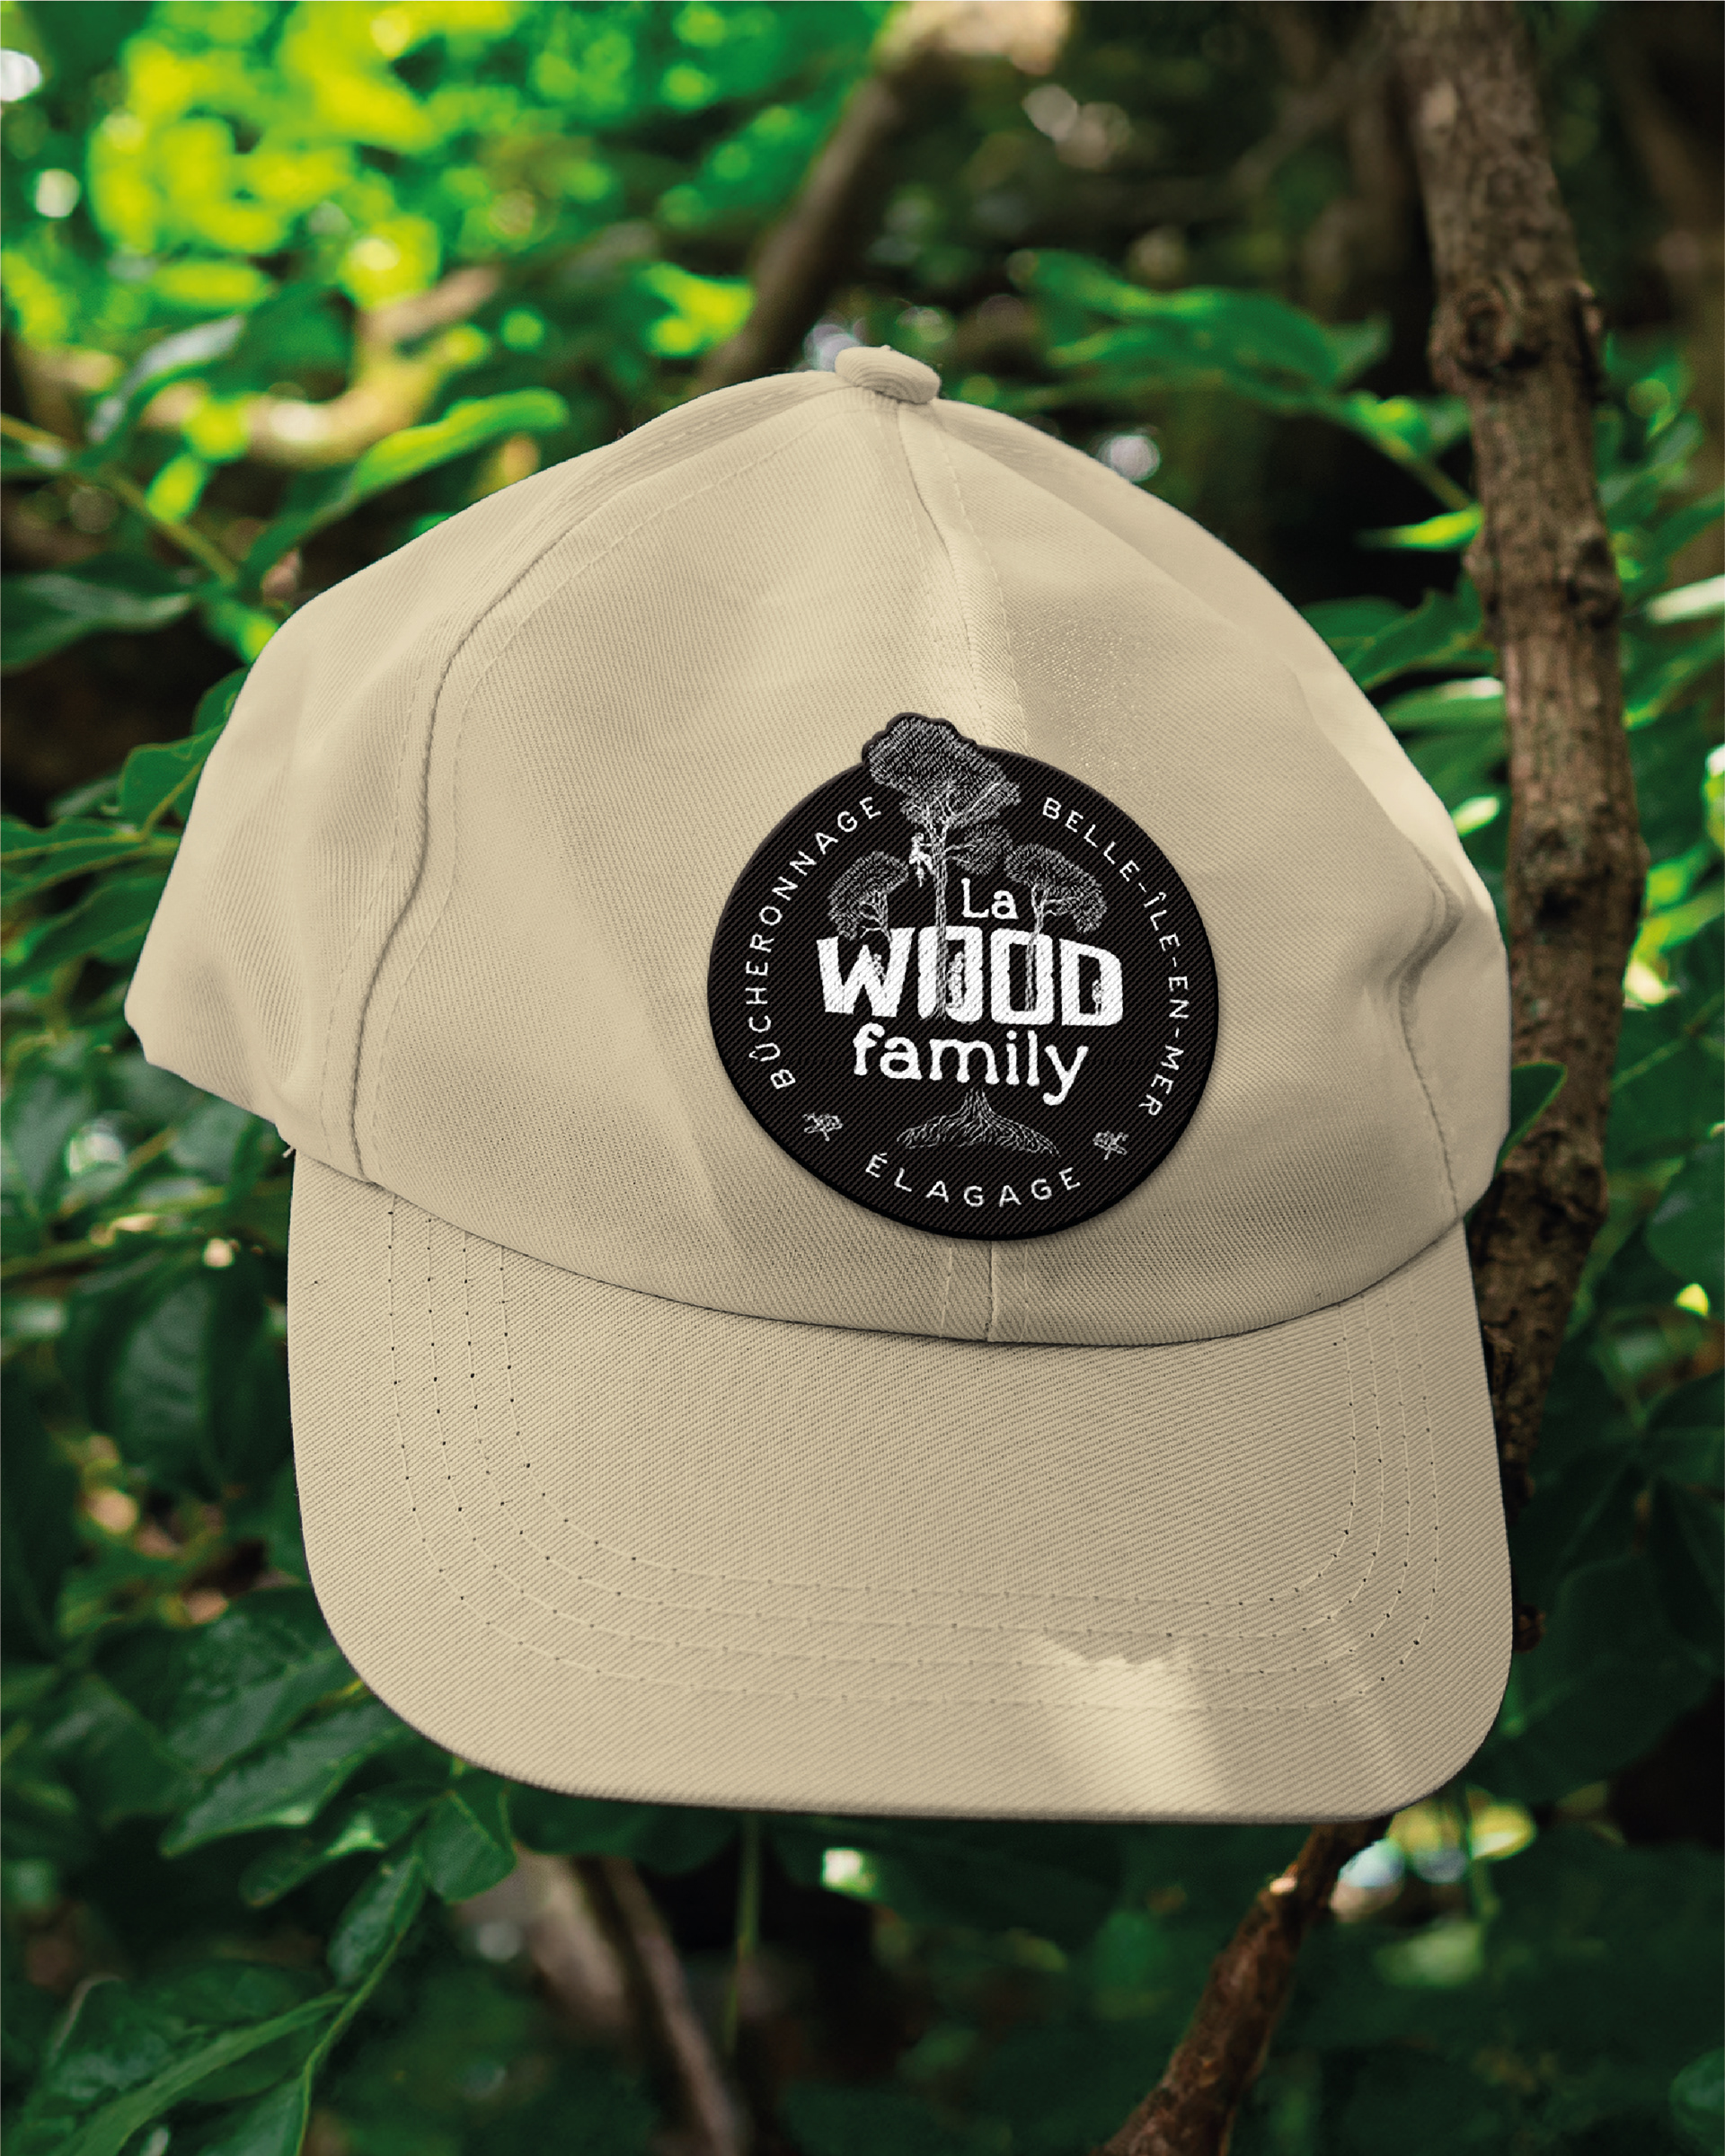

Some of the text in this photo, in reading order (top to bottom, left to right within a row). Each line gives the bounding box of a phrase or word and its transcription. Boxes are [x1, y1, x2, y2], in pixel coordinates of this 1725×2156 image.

[745, 796, 881, 1090] BÛCHERONNAGE
[961, 878, 1018, 921] La
[816, 926, 1124, 1026] WOOD
[1042, 796, 1190, 1117] BELLE-ÎLE-EN-MER
[853, 1022, 1089, 1106] family
[865, 1153, 1081, 1207] ÉLAGAGE
